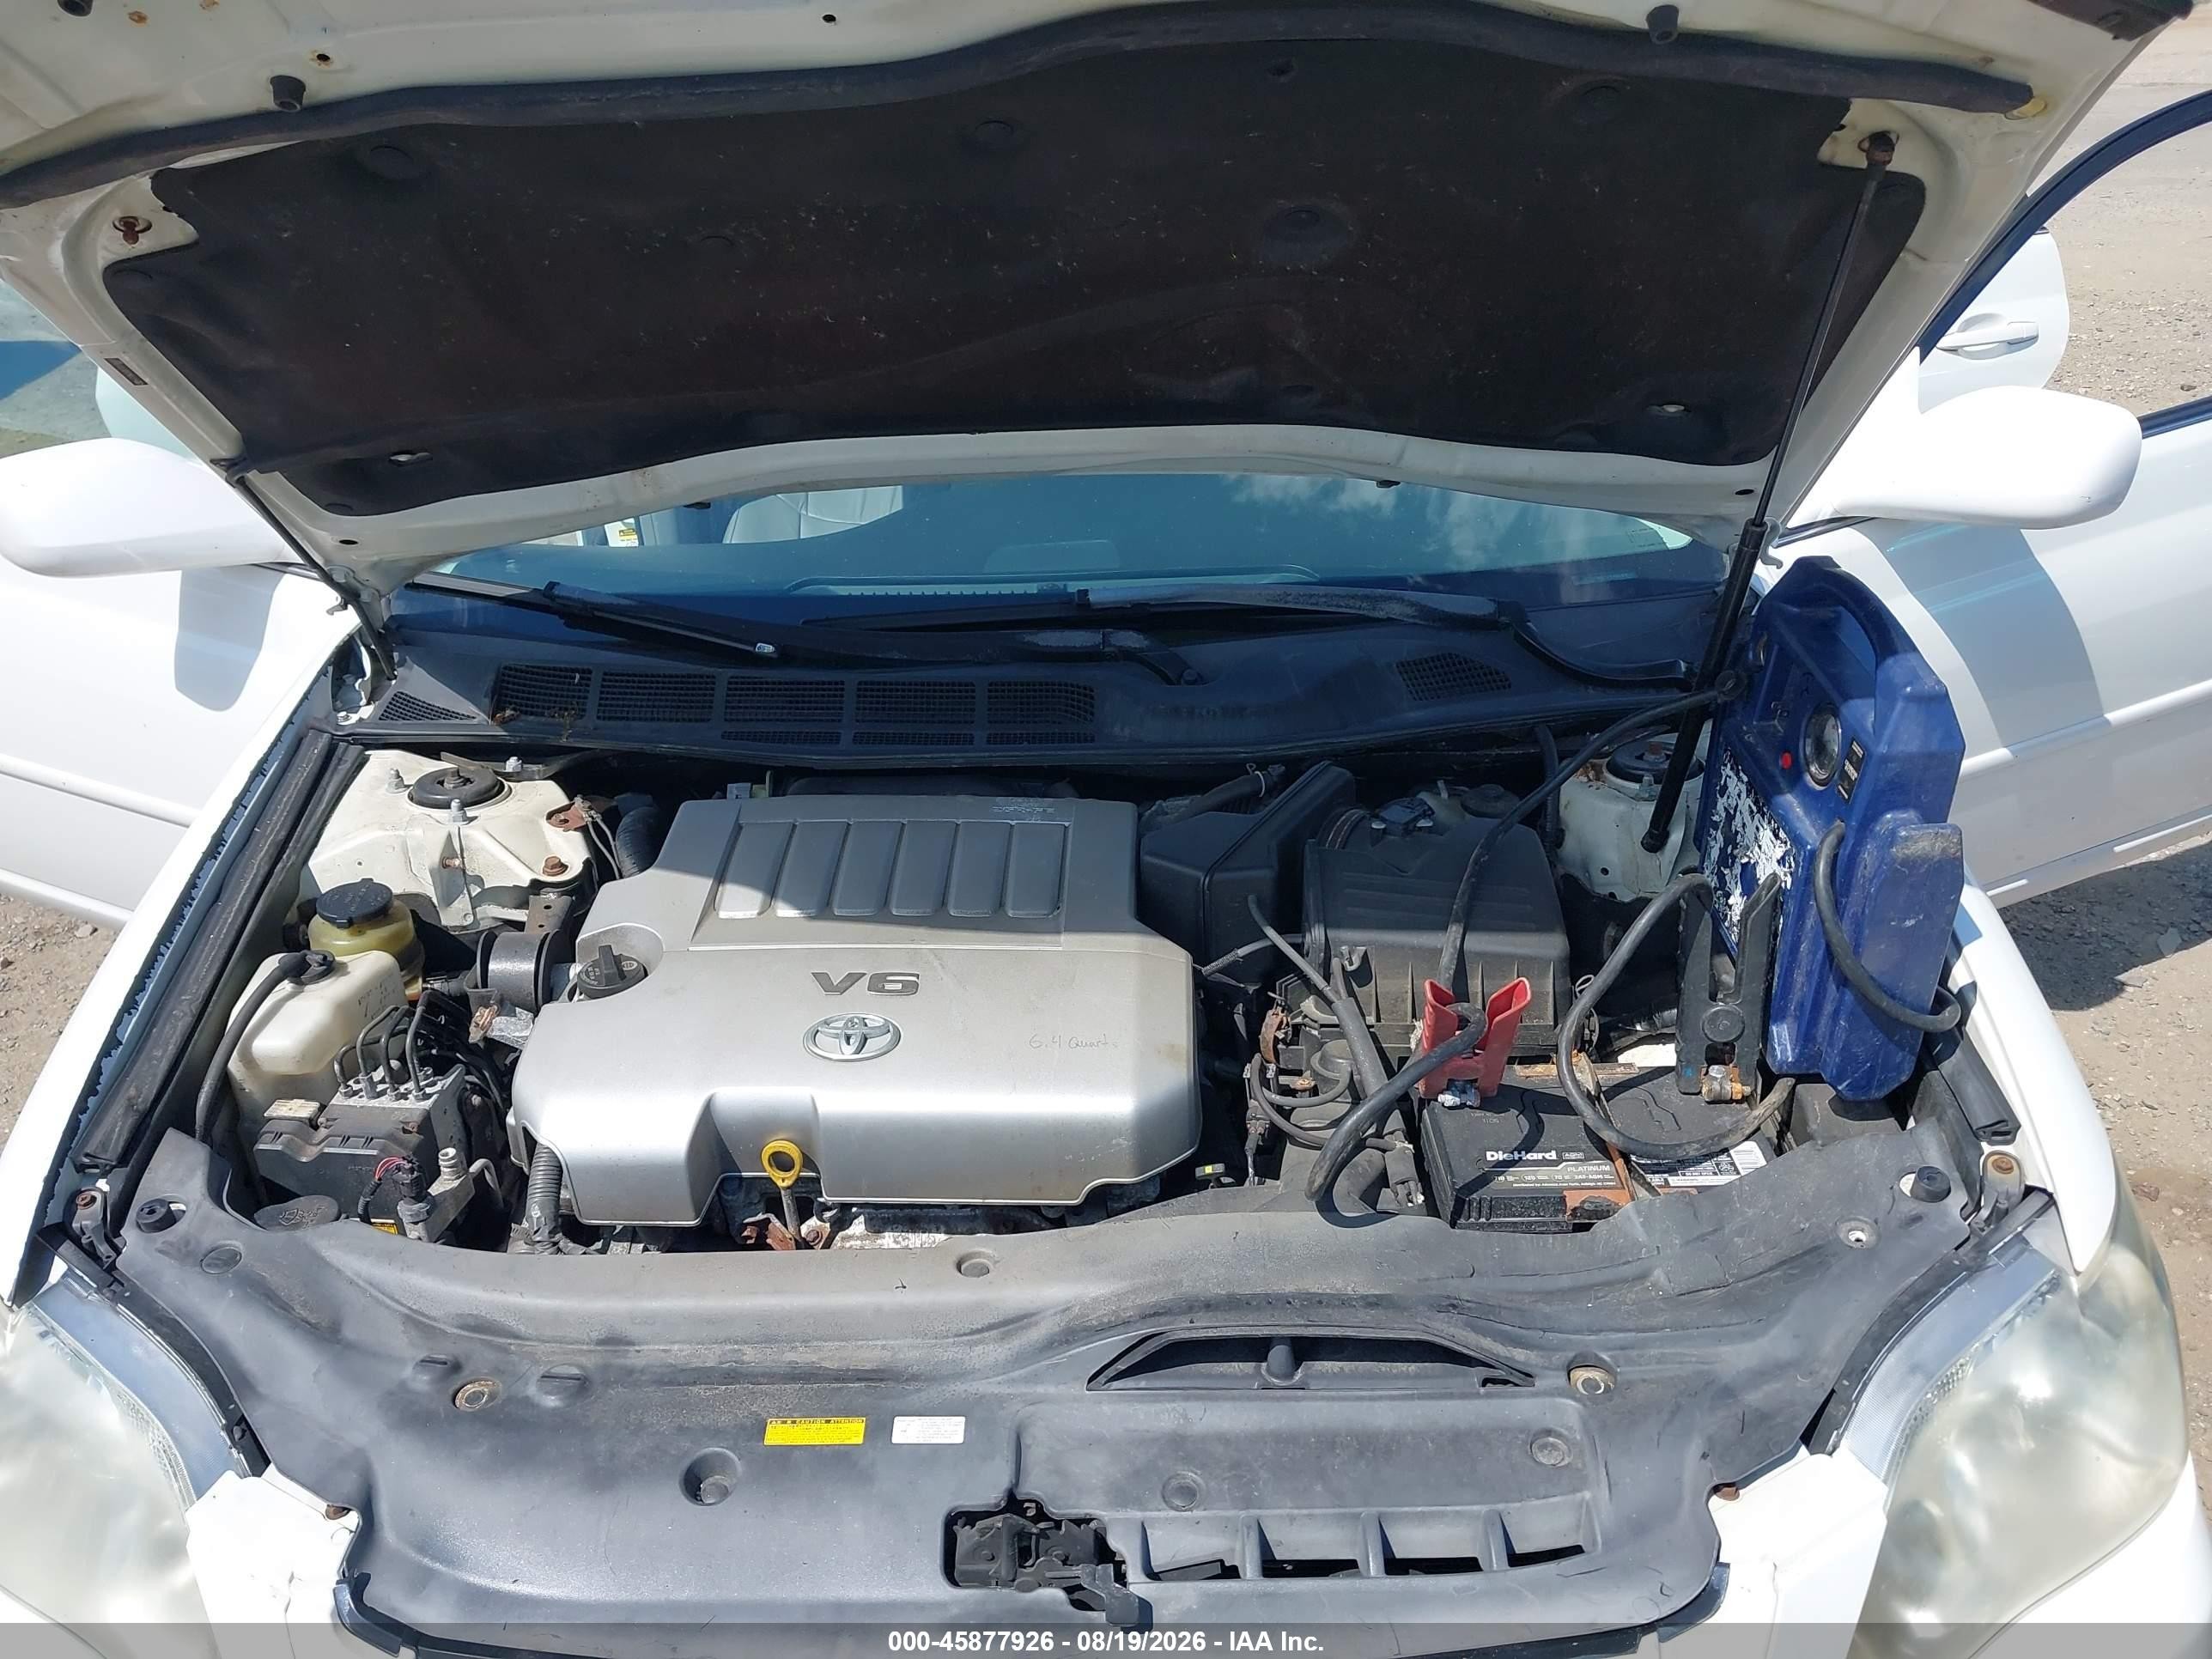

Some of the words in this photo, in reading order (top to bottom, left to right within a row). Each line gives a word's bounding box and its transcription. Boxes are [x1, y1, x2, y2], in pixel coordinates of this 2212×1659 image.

[811, 971, 920, 996] V6
[1029, 1033, 1061, 1048] 6.4
[1486, 1150, 1557, 1161] DieHard
[1567, 1164, 1611, 1172] PLATINUM
